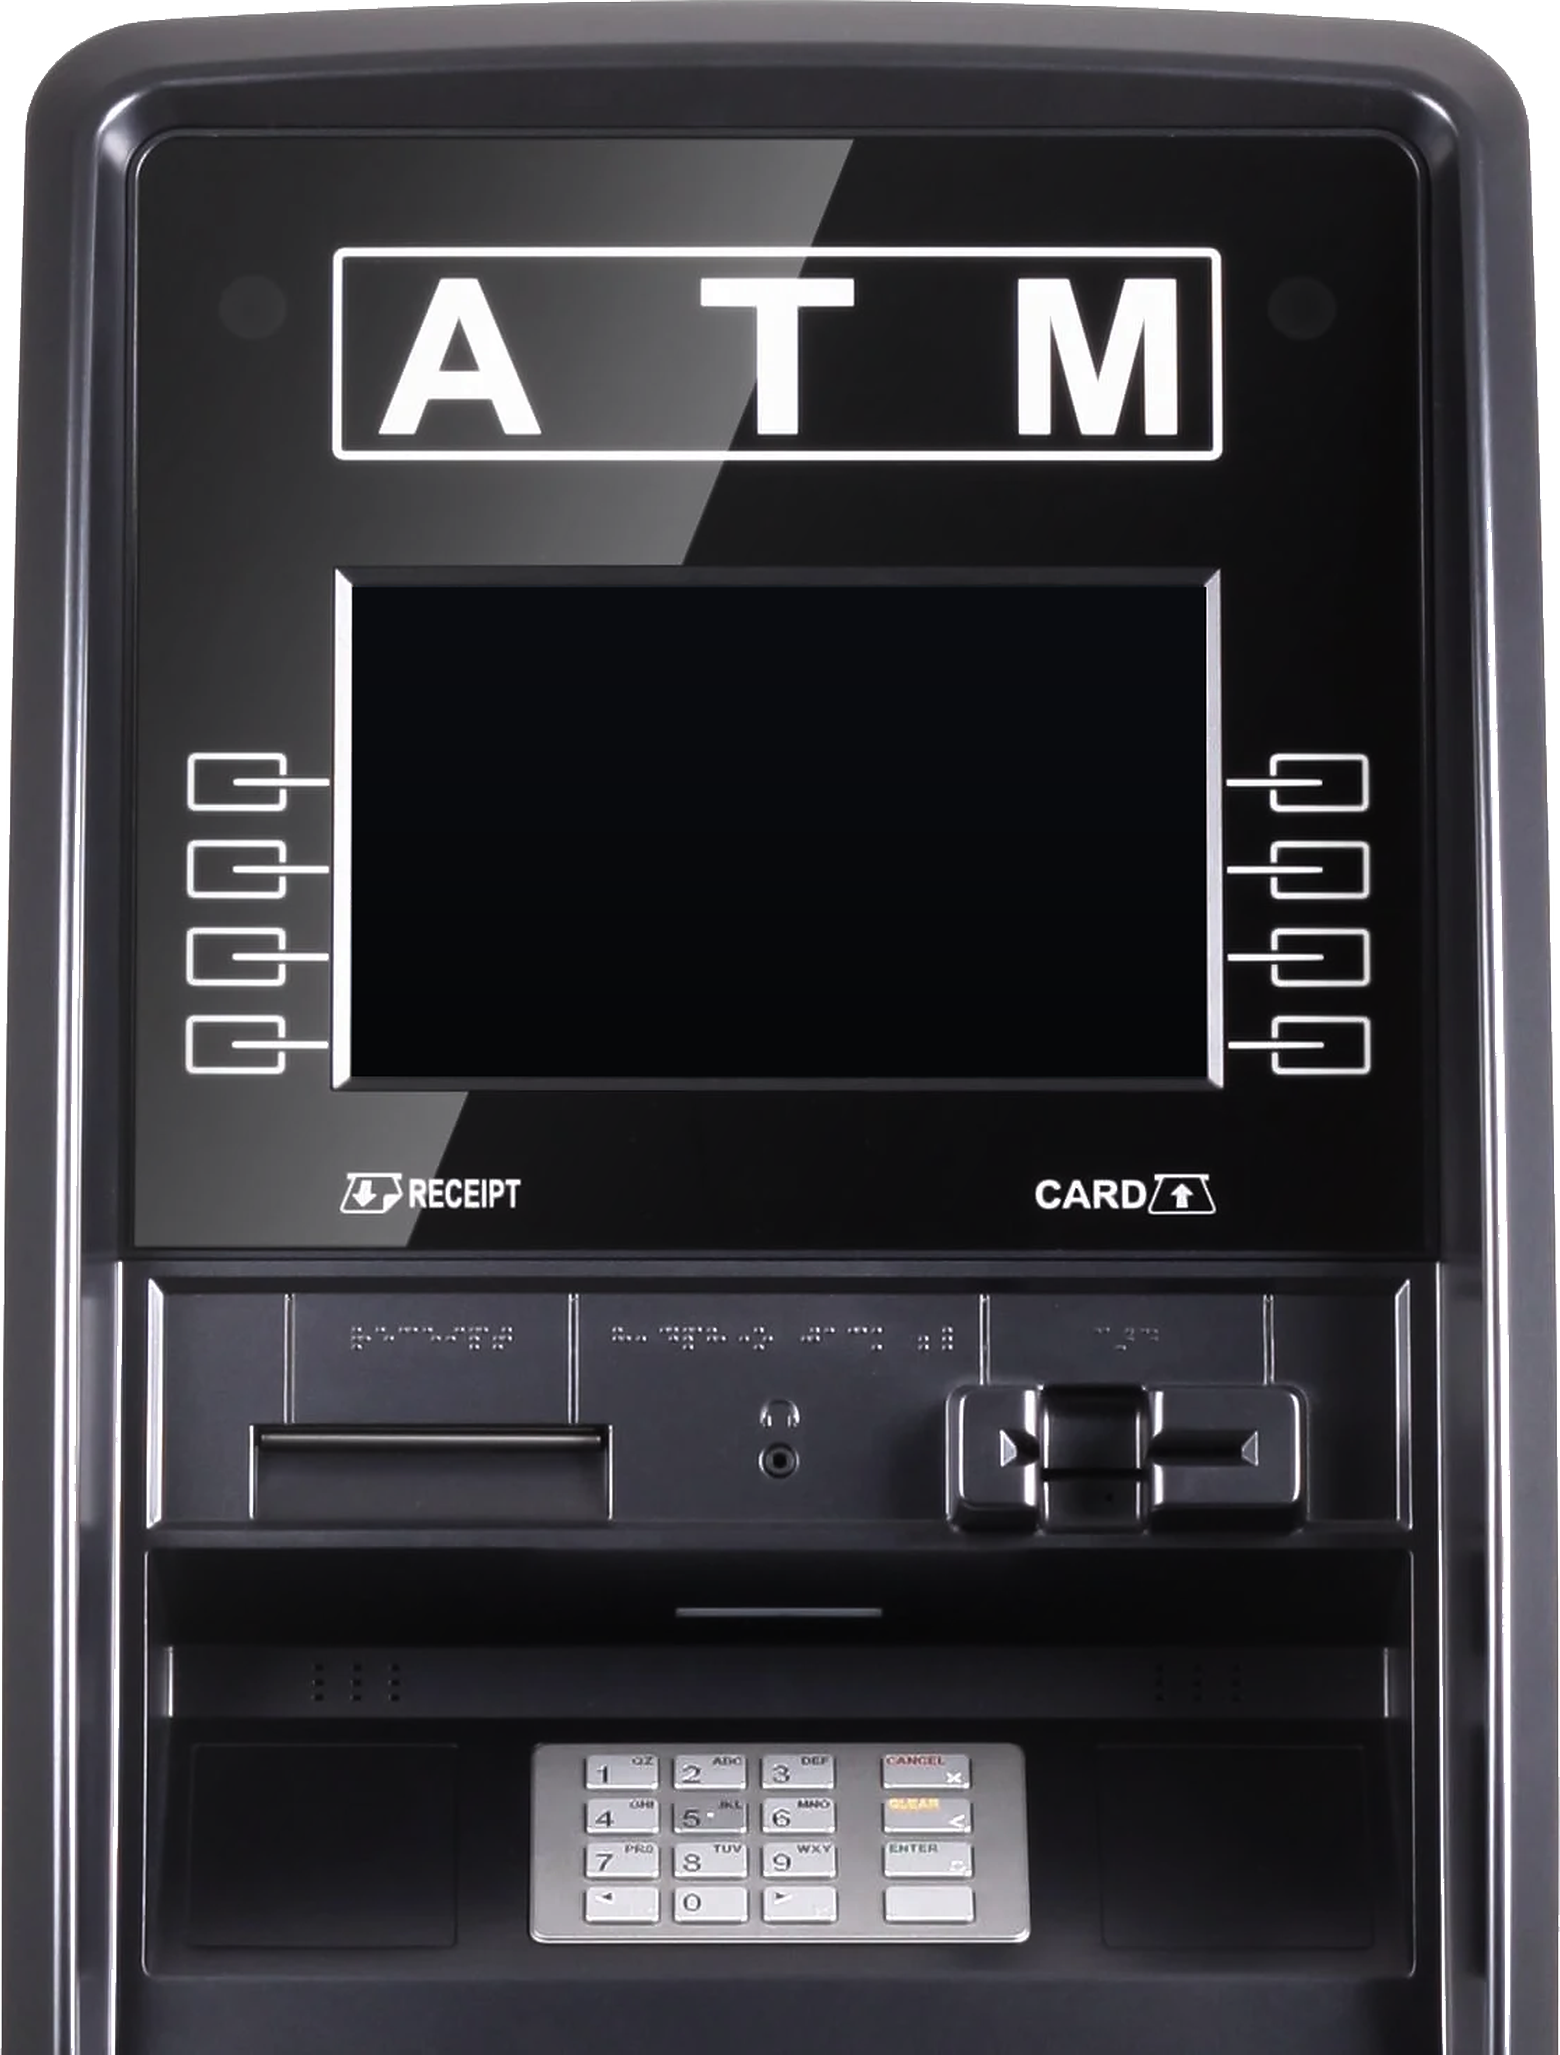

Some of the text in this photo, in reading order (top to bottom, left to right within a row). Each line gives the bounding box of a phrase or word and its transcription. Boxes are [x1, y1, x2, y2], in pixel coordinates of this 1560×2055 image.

[379, 278, 1177, 436] ATM
[408, 1178, 522, 1209] RECEIPT
[1035, 1179, 1147, 1210] CARD
[597, 1755, 655, 1785] 1 QZ
[773, 1755, 829, 1784] 3 DEF
[886, 1755, 946, 1767] CANCEL
[682, 1765, 701, 1784] 2
[595, 1810, 615, 1828] 4
[682, 1809, 701, 1828] 5
[772, 1808, 791, 1828] 6
[682, 1843, 743, 1873] 8 TUV
[772, 1843, 832, 1873] 9 WXY
[889, 1843, 939, 1854] ENTER
[595, 1853, 614, 1872] 7
[682, 1892, 702, 1913] 0
